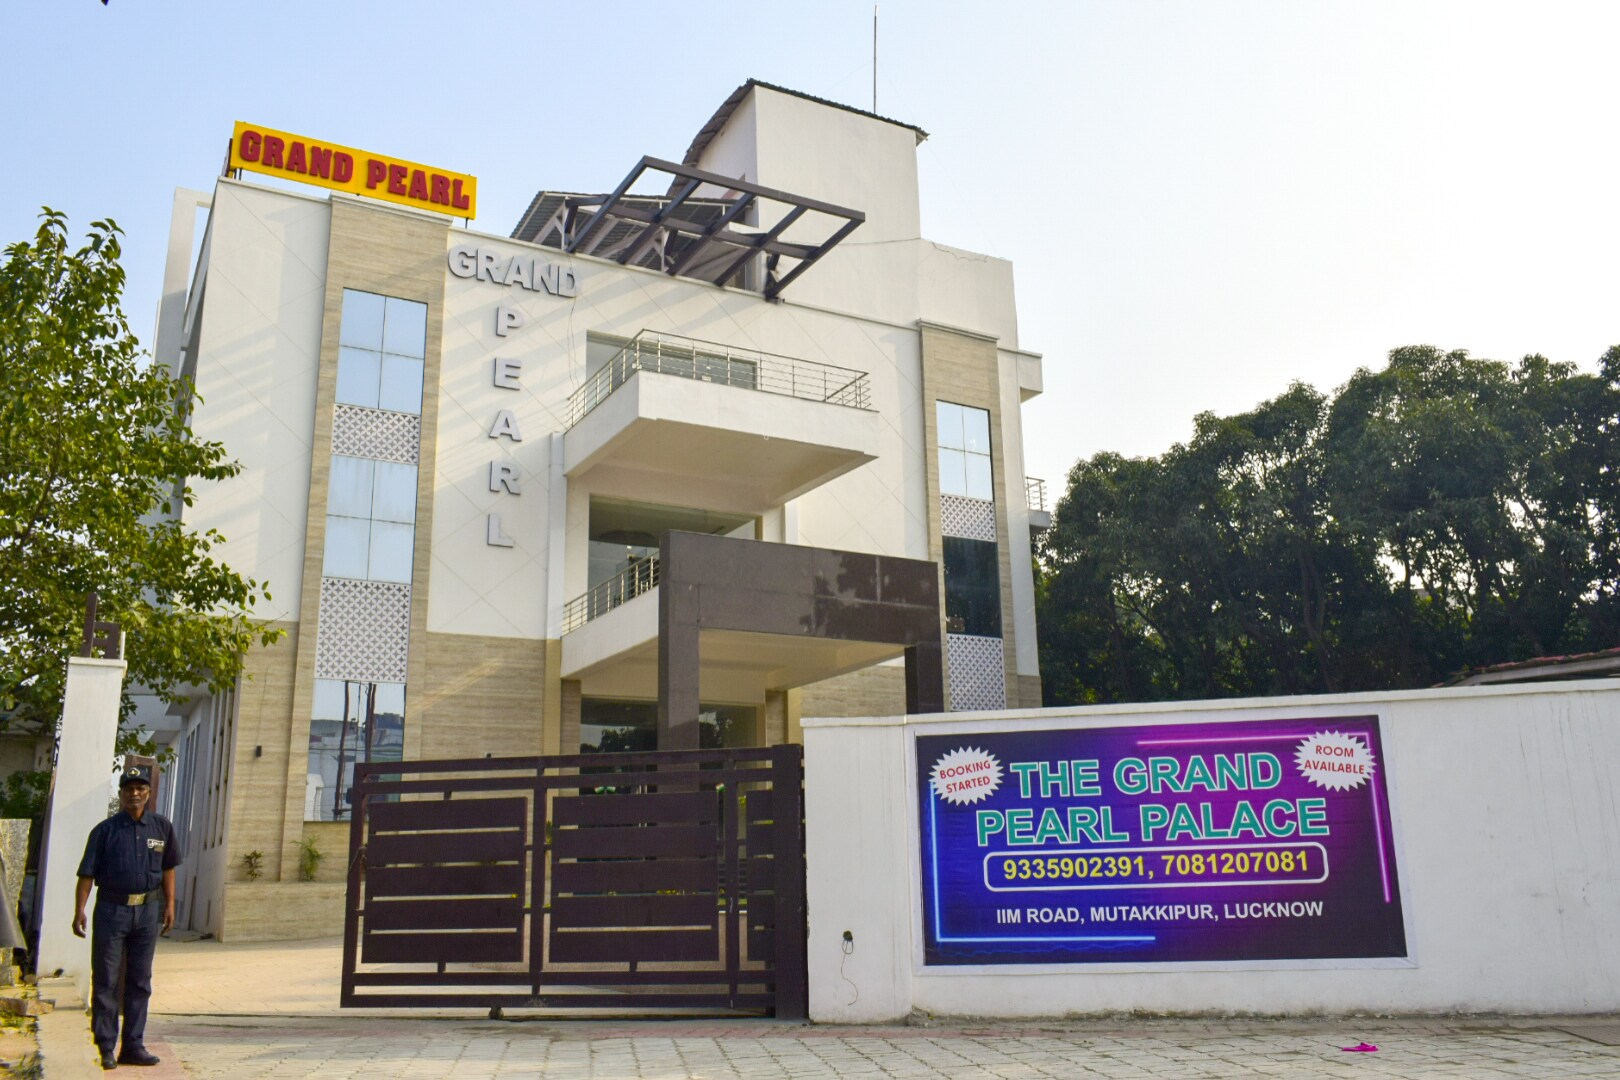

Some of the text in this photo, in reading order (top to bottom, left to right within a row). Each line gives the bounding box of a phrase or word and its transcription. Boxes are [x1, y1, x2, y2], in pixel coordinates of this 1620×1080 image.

[239, 130, 471, 210] GRAND PEARL
[447, 246, 577, 298] GRAND
[1315, 744, 1354, 758] ROOM
[939, 759, 991, 779] BOOKING
[1010, 752, 1282, 799] THE GRAND
[1304, 759, 1365, 776] AVAILABLE
[946, 775, 991, 793] STARTED
[976, 797, 1330, 846] PEARL PALACE
[1003, 850, 1308, 880] 9335902391, 7081207081
[996, 901, 1324, 925] IIM ROAD, MUTAKKIPUR, LUCKNOW
